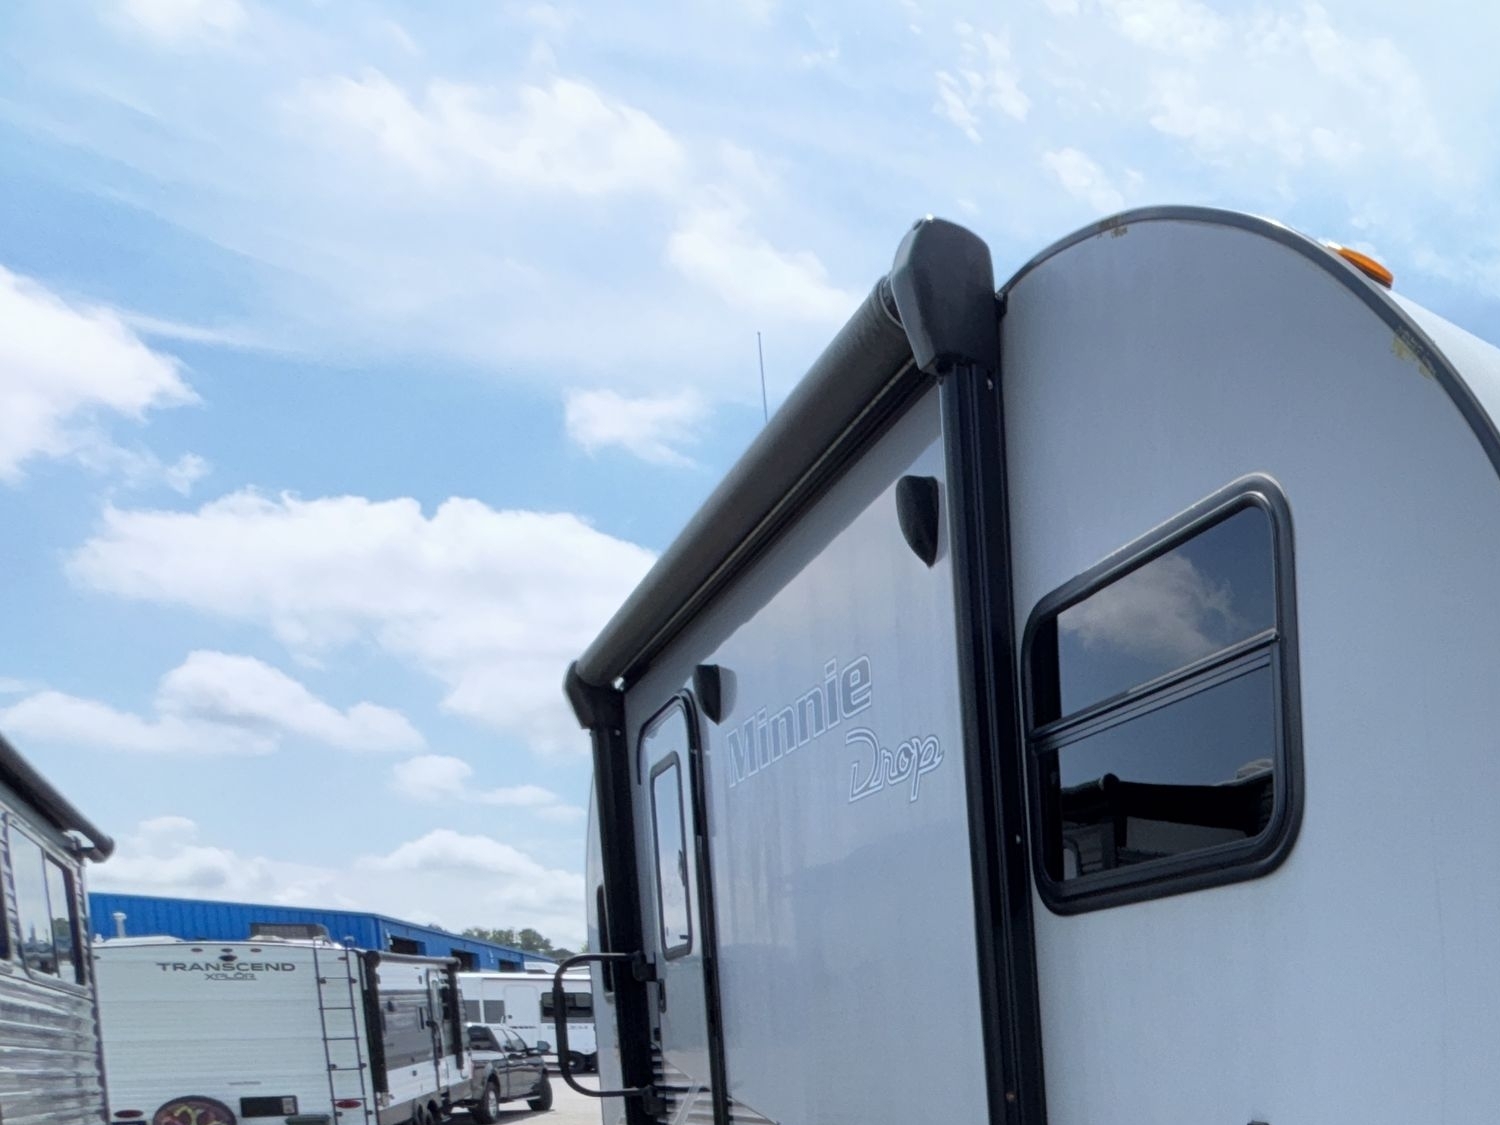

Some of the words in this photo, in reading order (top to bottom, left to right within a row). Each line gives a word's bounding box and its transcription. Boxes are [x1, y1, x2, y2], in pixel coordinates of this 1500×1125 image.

[725, 654, 873, 790] Minnie
[845, 726, 945, 803] Drop
[156, 962, 296, 972] TRANSCEND
